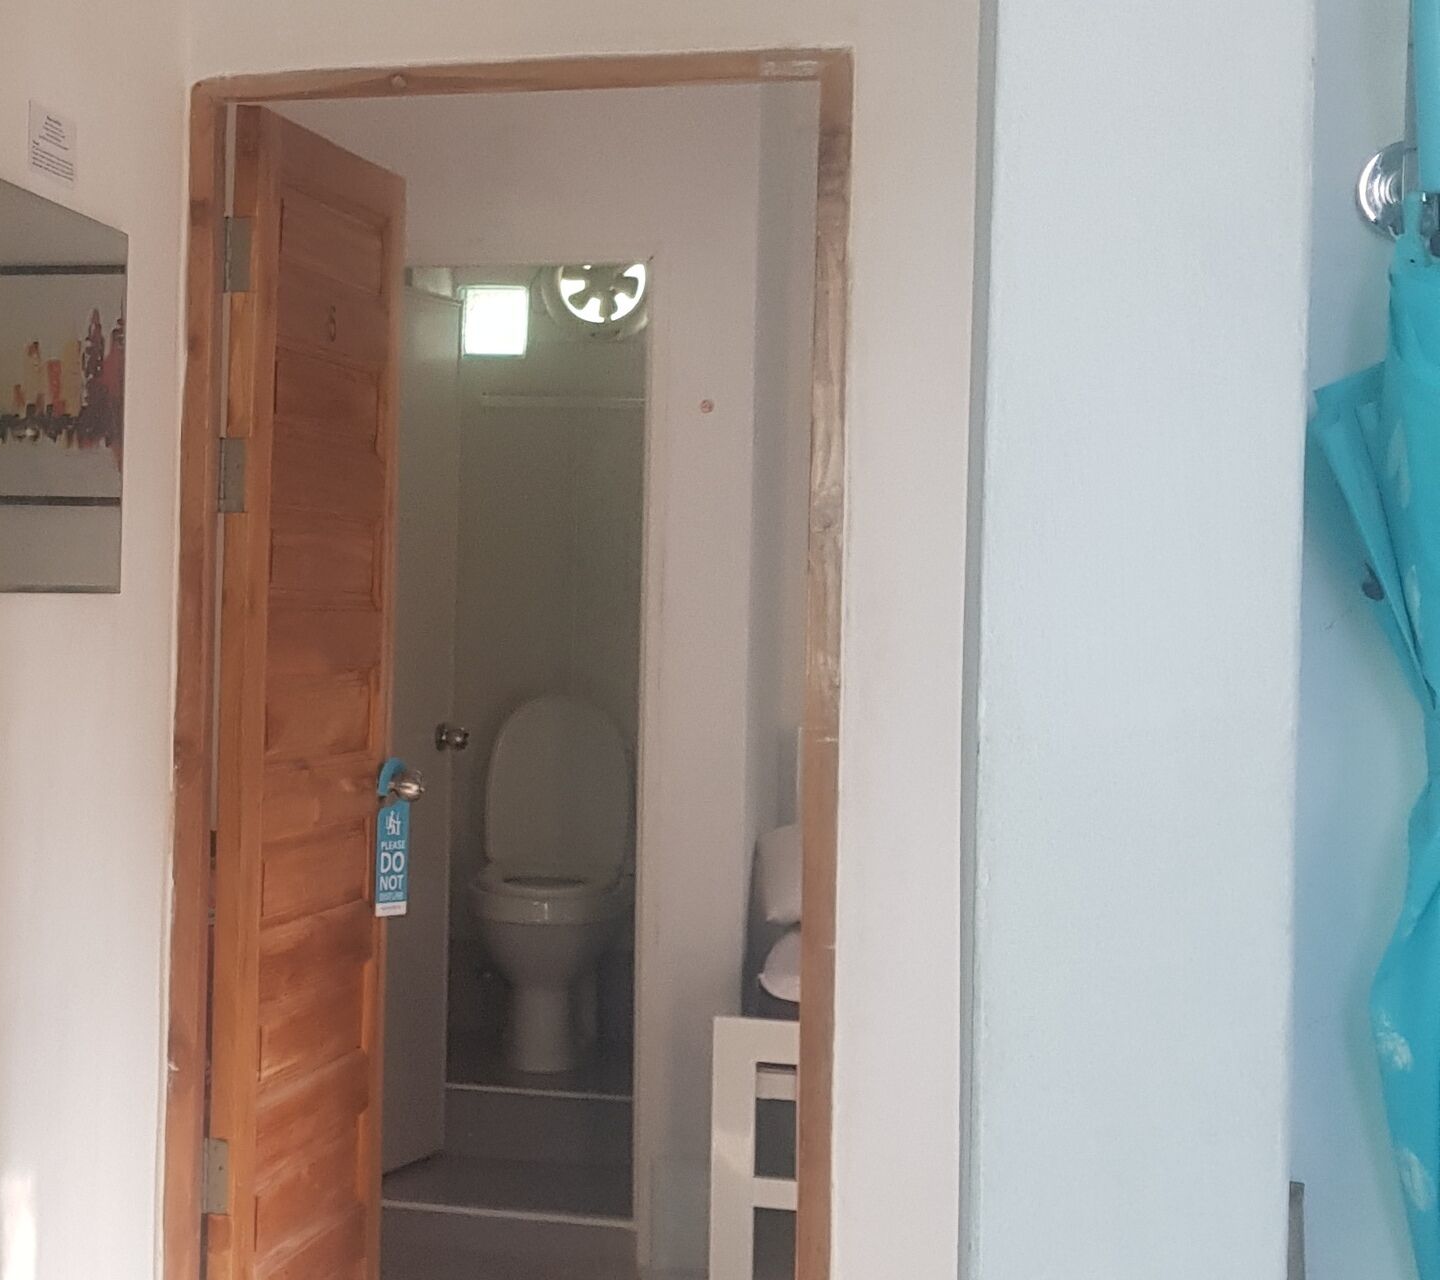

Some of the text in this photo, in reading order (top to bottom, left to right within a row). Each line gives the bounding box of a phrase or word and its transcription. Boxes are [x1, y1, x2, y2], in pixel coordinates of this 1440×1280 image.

[381, 840, 405, 850] PLEASE
[380, 851, 405, 873] DO
[379, 874, 404, 891] NOT
